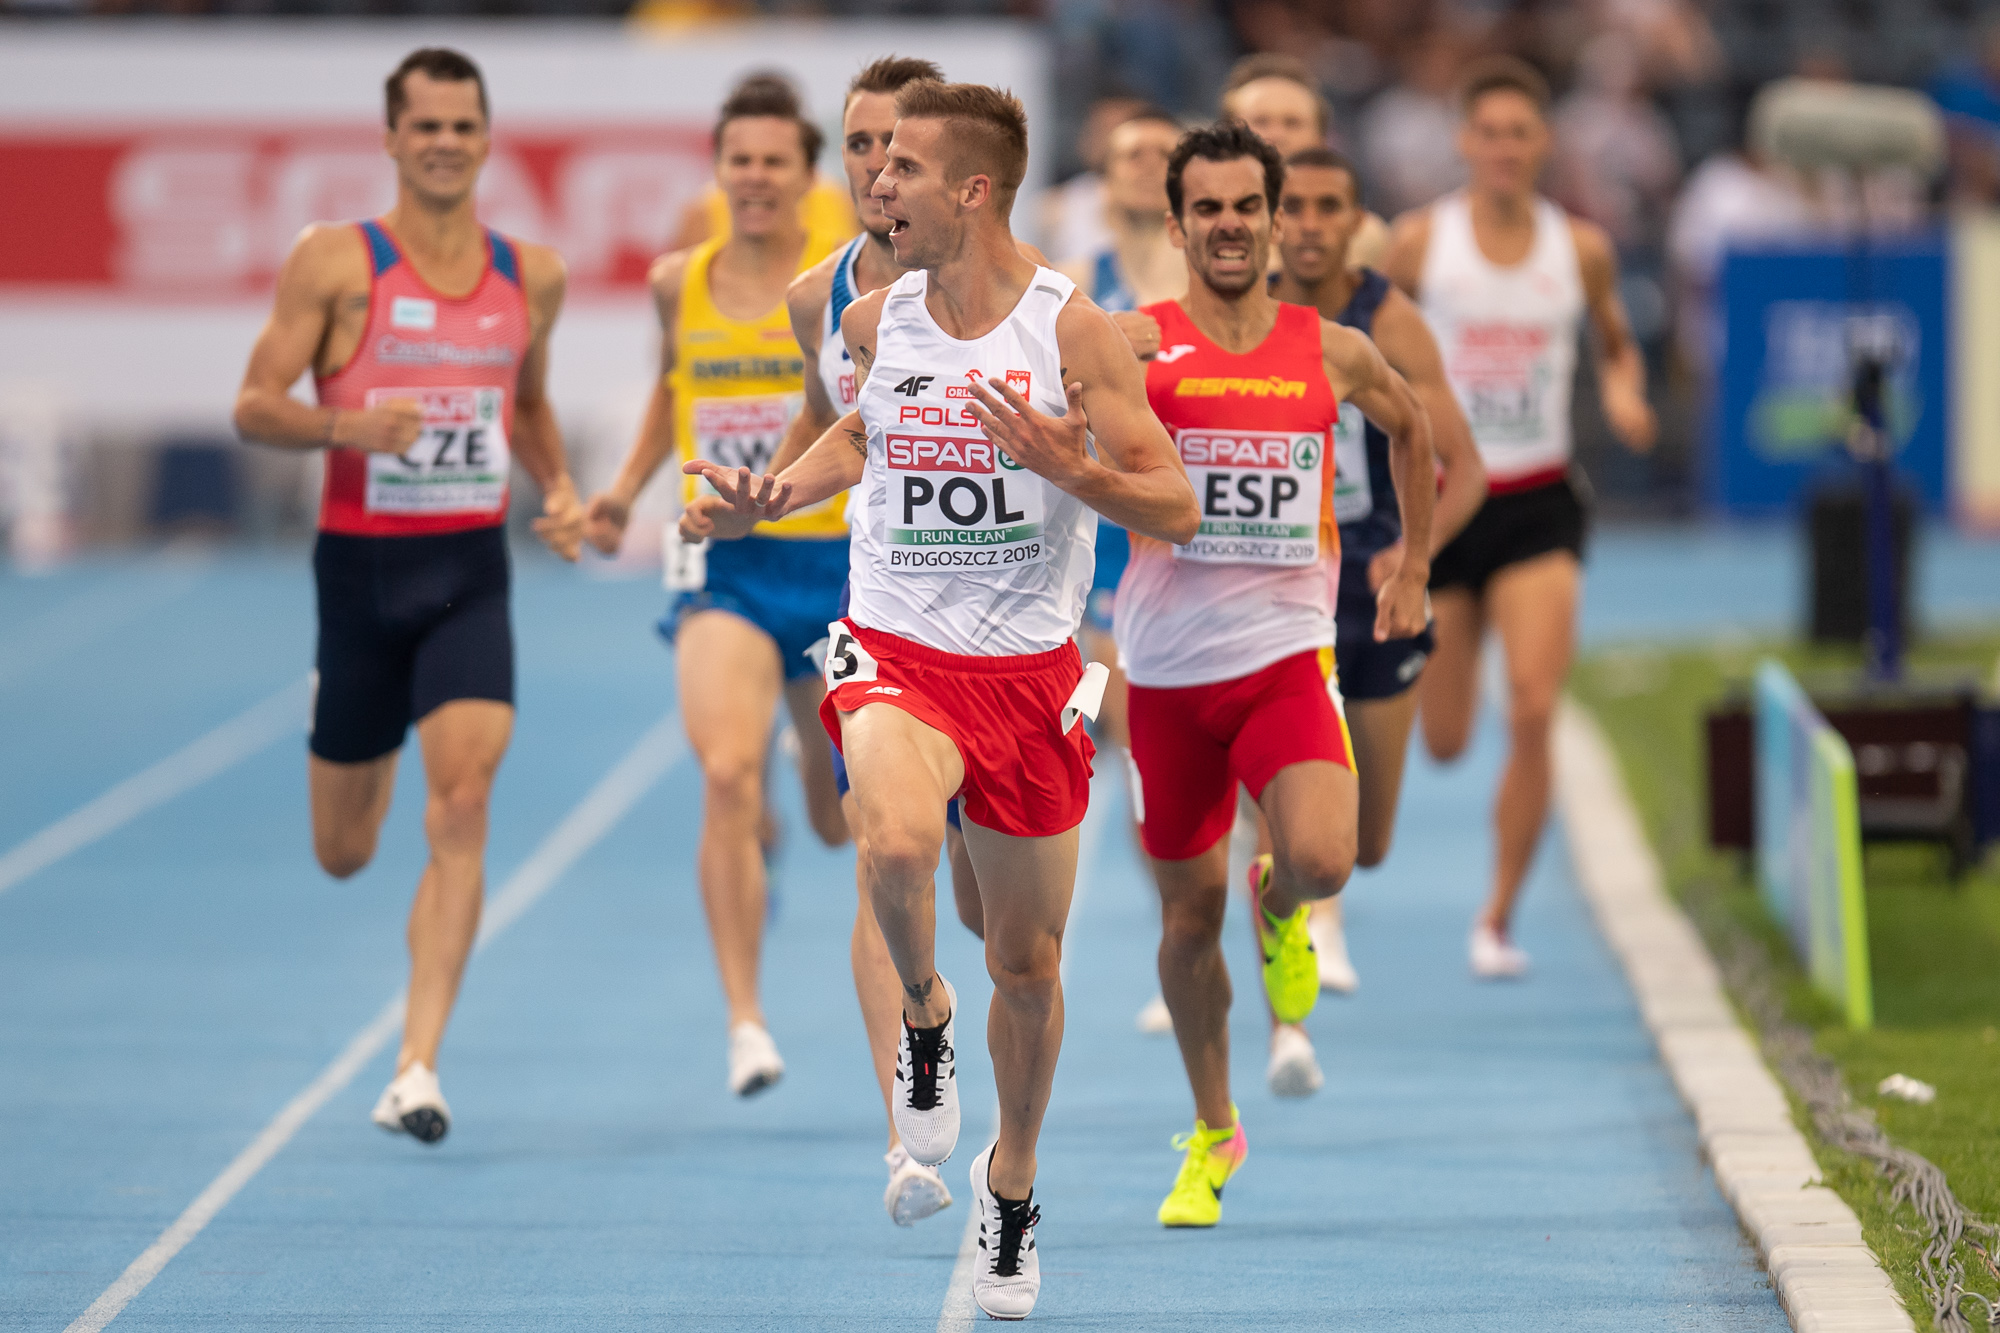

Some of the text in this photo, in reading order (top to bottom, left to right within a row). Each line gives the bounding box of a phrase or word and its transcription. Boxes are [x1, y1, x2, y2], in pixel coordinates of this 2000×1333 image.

[1175, 376, 1307, 397] ESPAÑA
[890, 440, 992, 469] SPAR
[1183, 437, 1288, 465] SPAR
[903, 475, 1024, 526] POL
[1204, 472, 1299, 518] ESP
[913, 531, 917, 543] I
[921, 531, 954, 543] RUN
[1213, 523, 1241, 534] RUN
[1245, 524, 1291, 537] CLEAN
[891, 543, 1040, 566] BYDGOSZCZ 2019
[833, 634, 858, 680] 5
